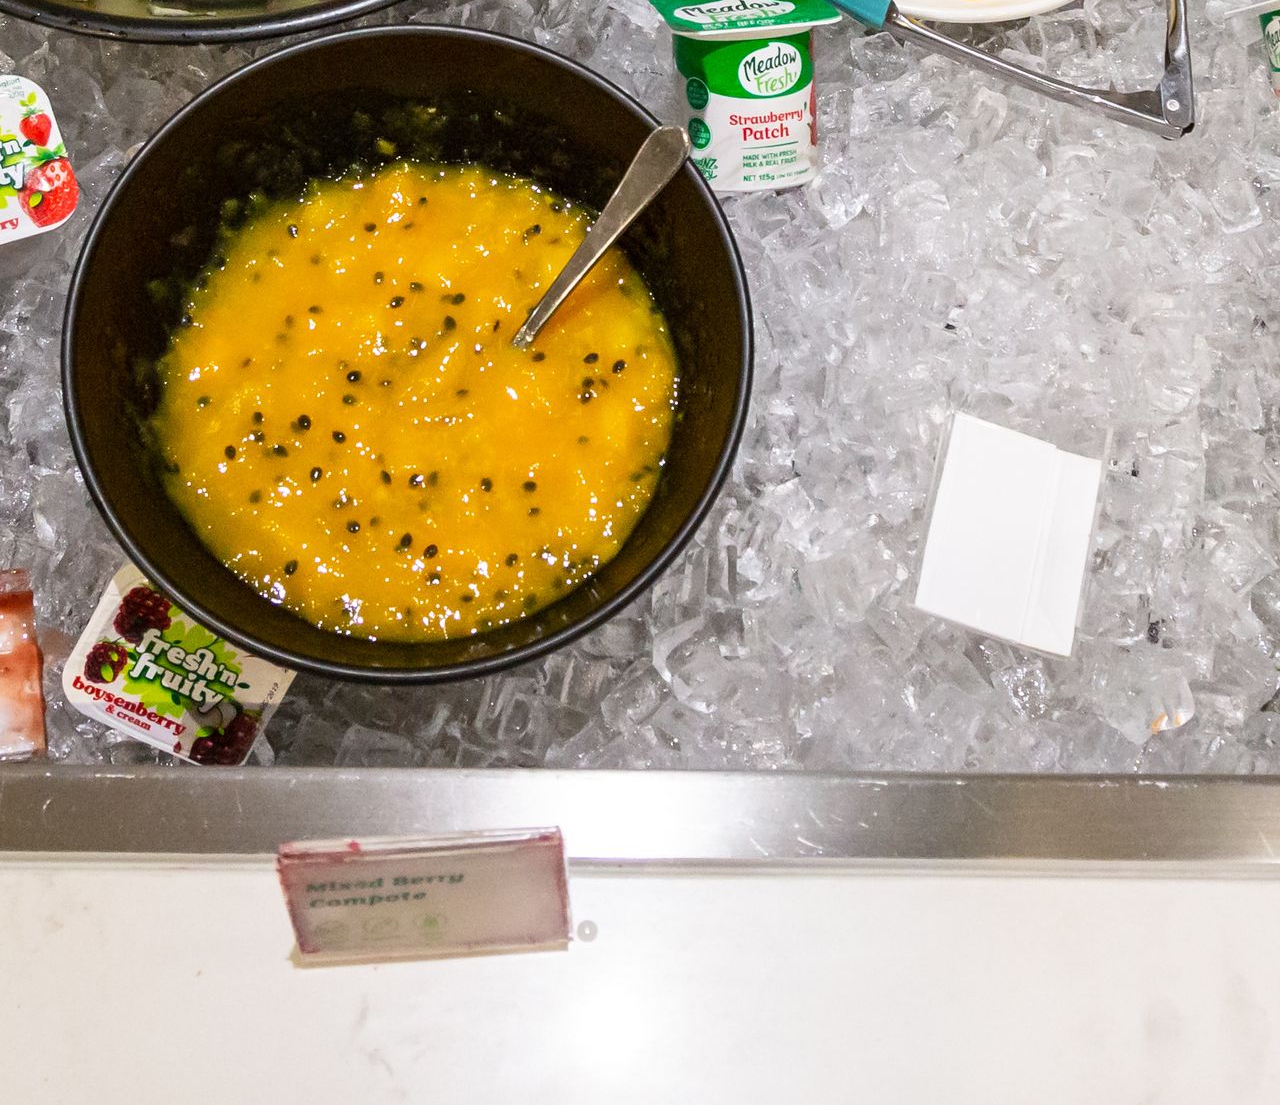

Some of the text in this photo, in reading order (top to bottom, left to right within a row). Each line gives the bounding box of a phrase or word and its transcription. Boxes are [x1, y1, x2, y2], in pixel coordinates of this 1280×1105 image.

[681, 0, 780, 17] Meadow
[743, 46, 797, 81] Meadow
[754, 72, 795, 94] Fresh
[729, 108, 803, 126] Strawberry
[742, 123, 790, 141] Patch
[135, 628, 237, 687] fresh'n
[129, 652, 225, 714] fruity
[72, 675, 187, 736] boysenberry
[105, 705, 152, 732] & cream
[306, 873, 464, 893] Mixed Berry
[309, 891, 427, 909] Compote
